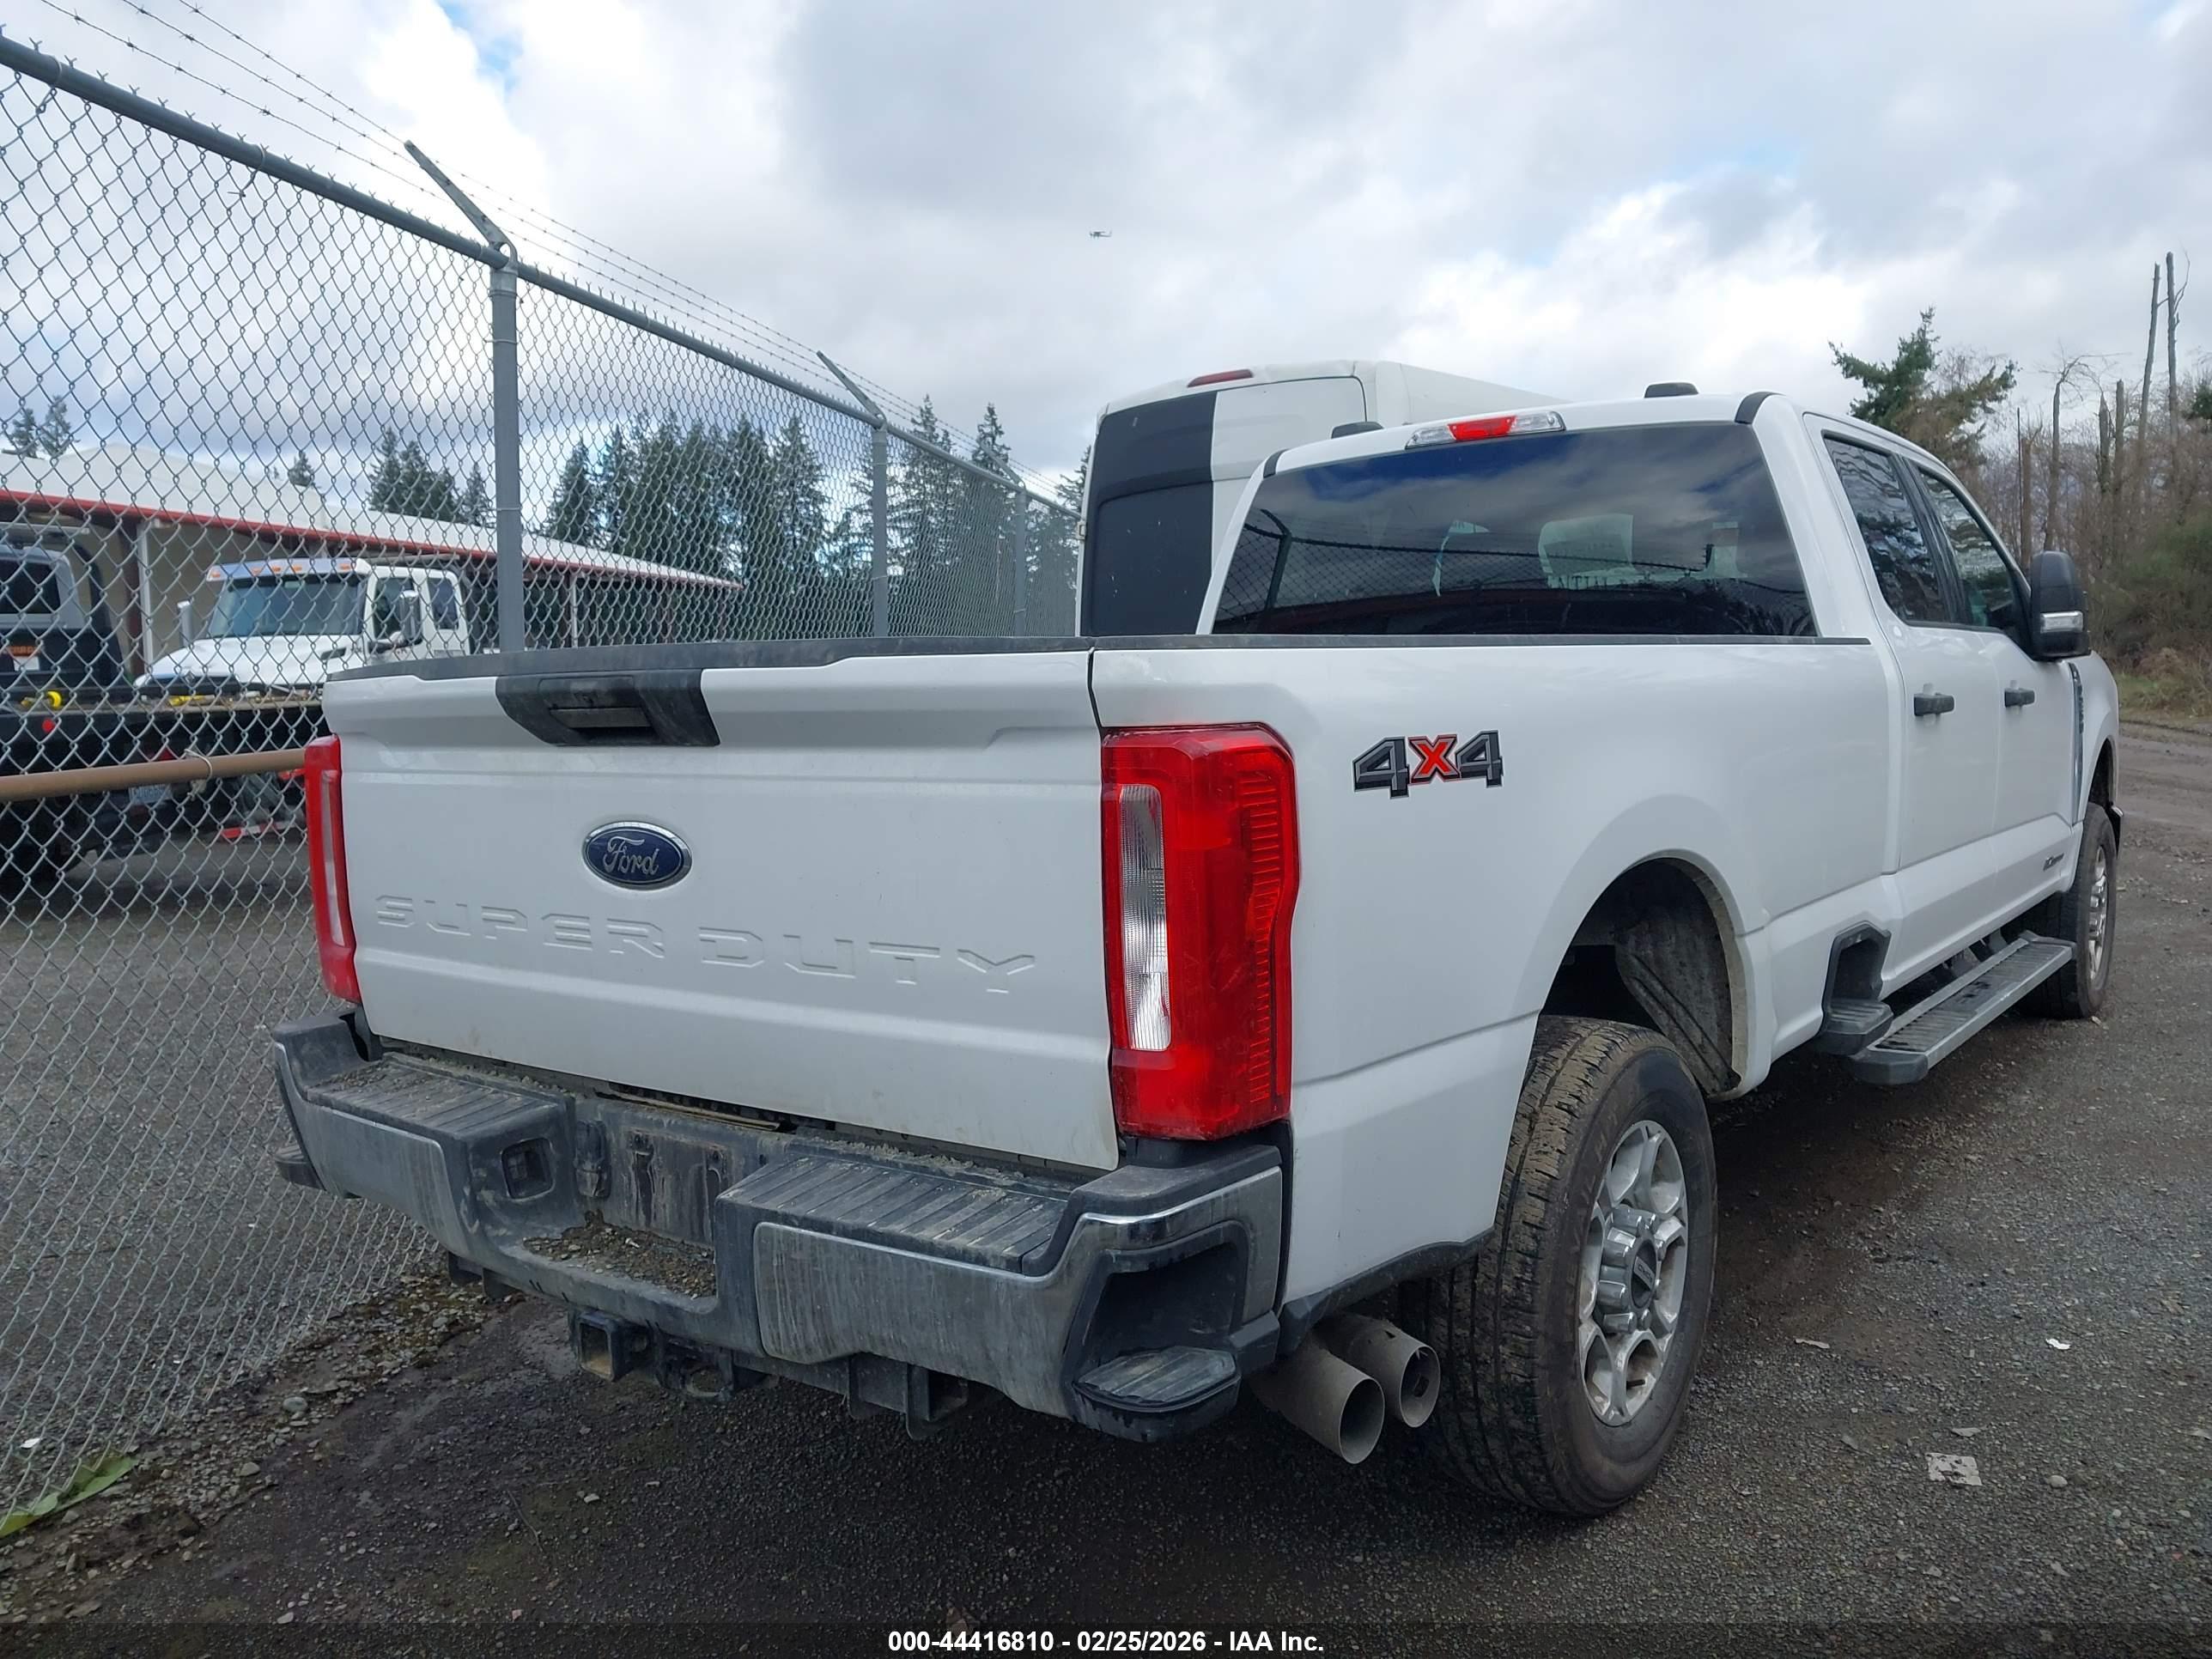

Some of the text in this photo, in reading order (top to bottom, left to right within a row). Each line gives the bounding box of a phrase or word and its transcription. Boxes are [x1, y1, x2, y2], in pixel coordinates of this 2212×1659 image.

[603, 836, 659, 875] Ford
[375, 895, 1036, 994] SUPER DUTY
